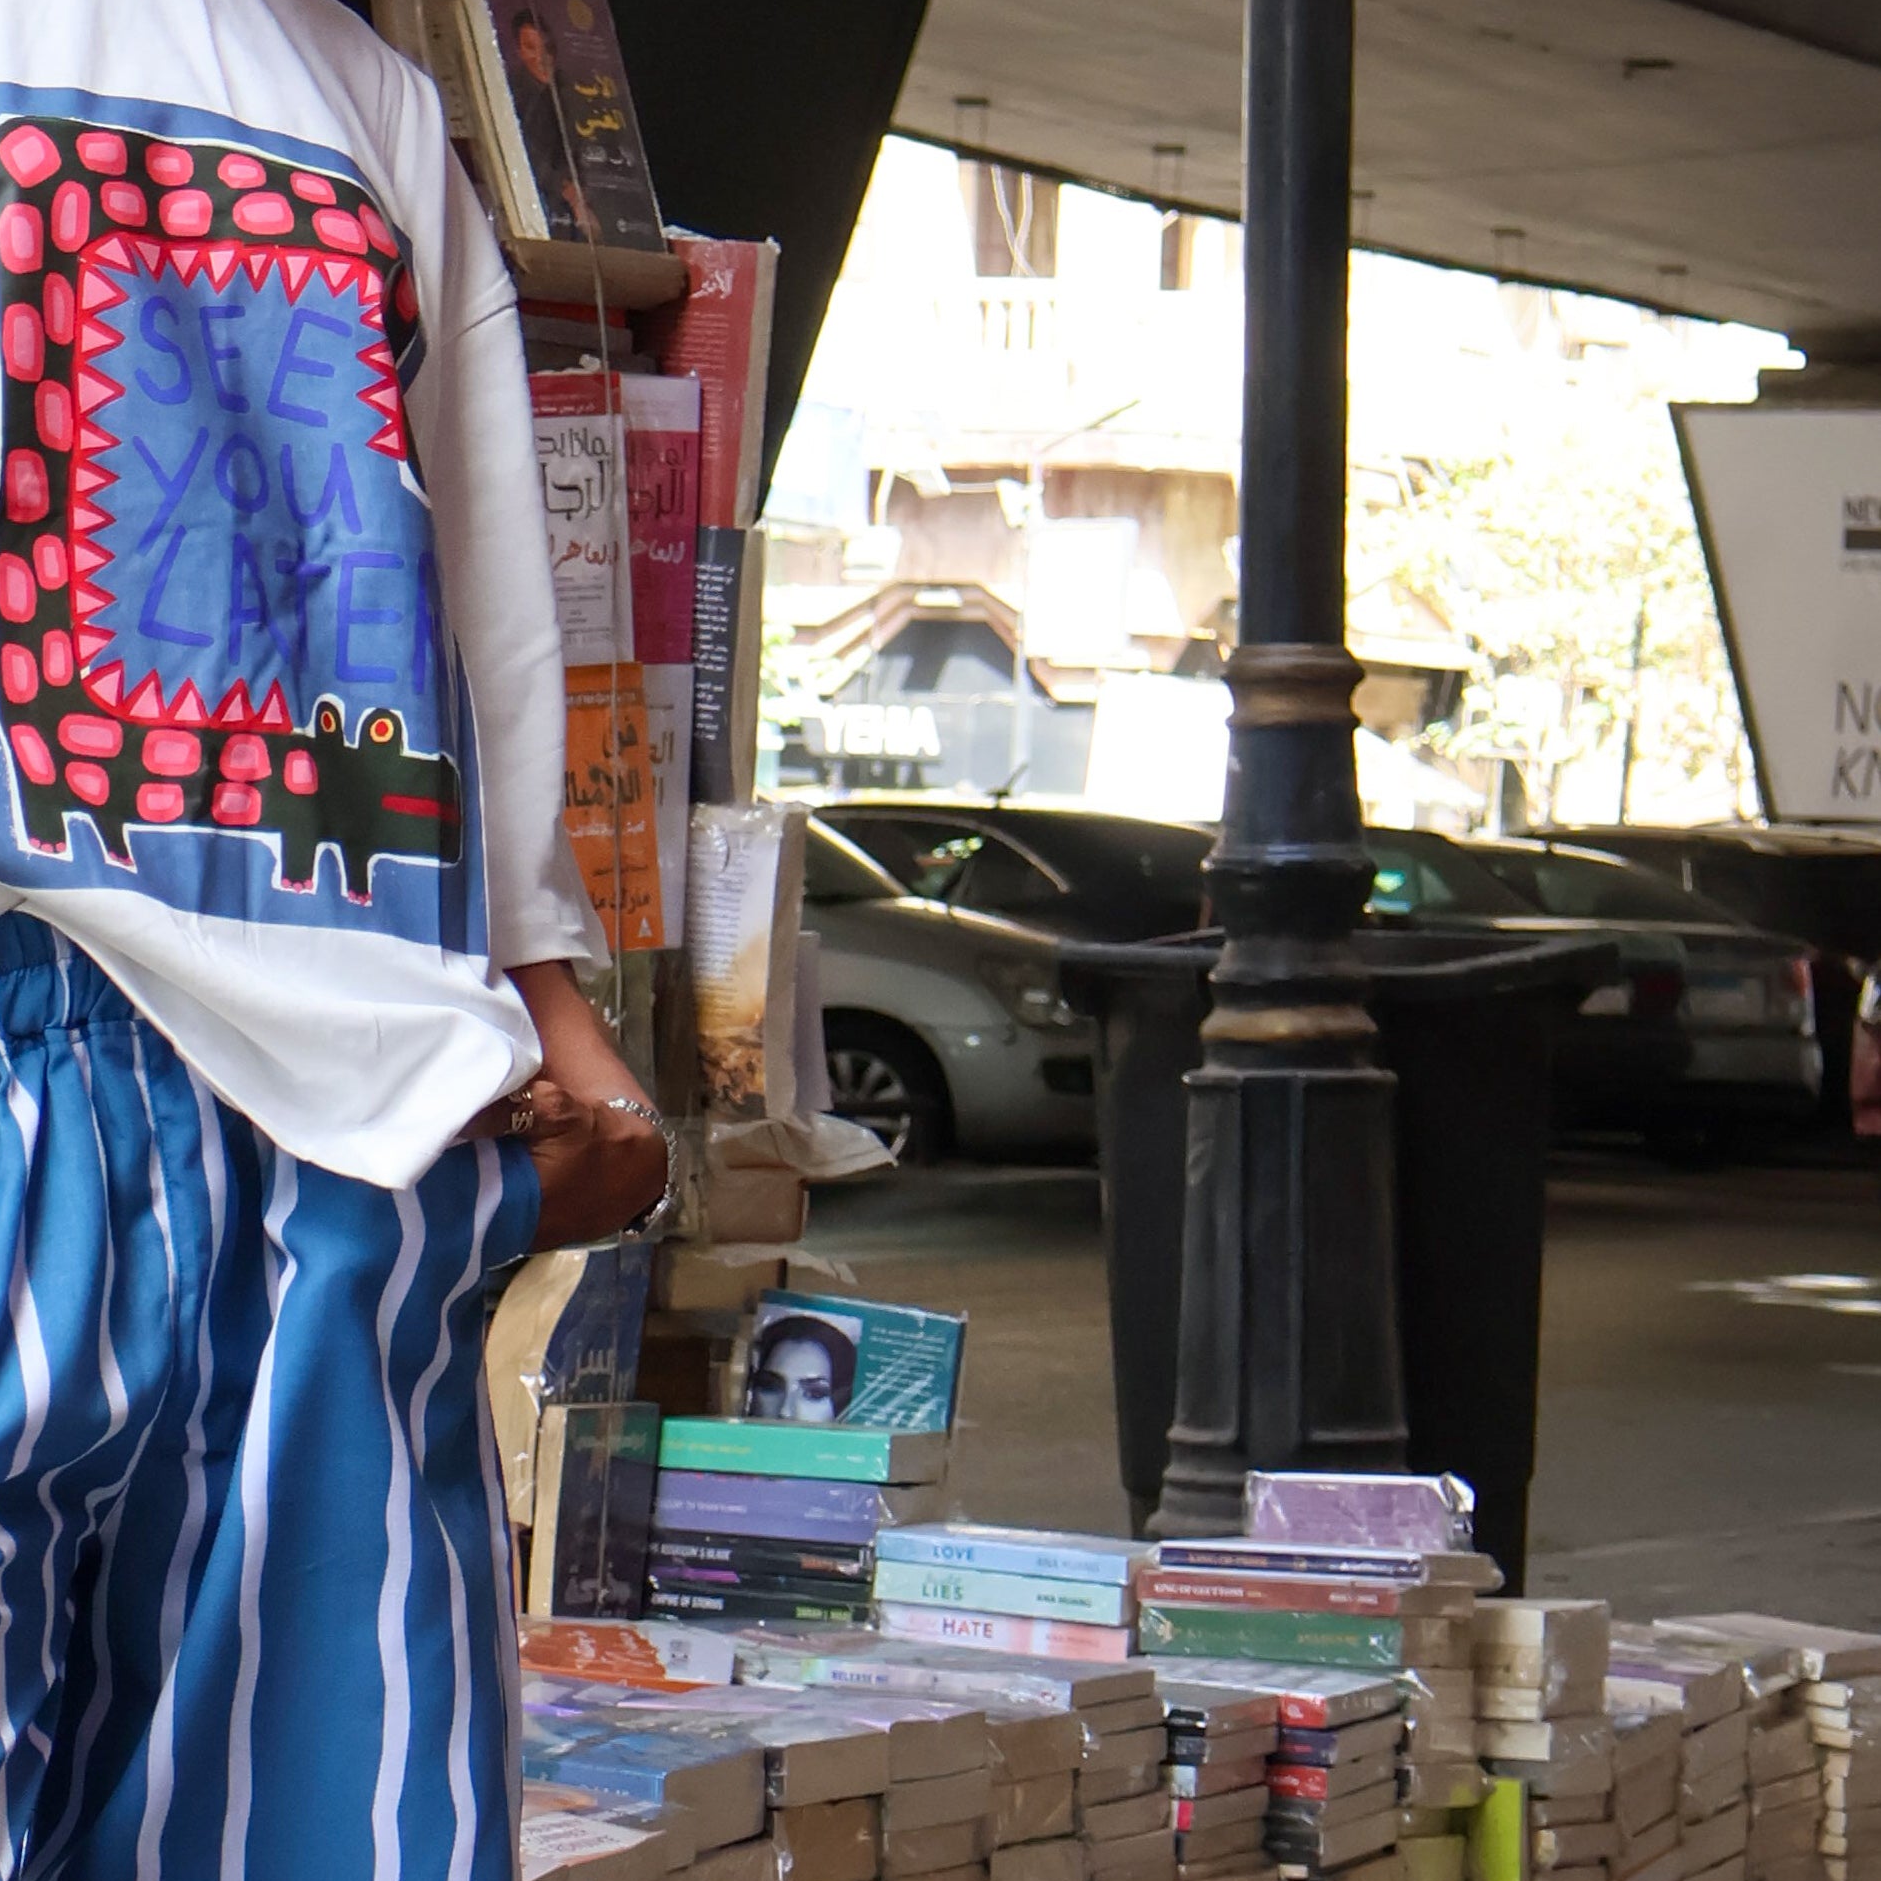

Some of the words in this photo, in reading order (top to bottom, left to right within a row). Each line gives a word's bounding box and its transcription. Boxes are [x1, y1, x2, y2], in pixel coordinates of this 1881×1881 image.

[132, 296, 352, 428] SEE
[132, 427, 363, 554] YOU
[933, 1544, 975, 1562] LOVE
[921, 1583, 964, 1601] LIES
[942, 1617, 994, 1638] HATE
